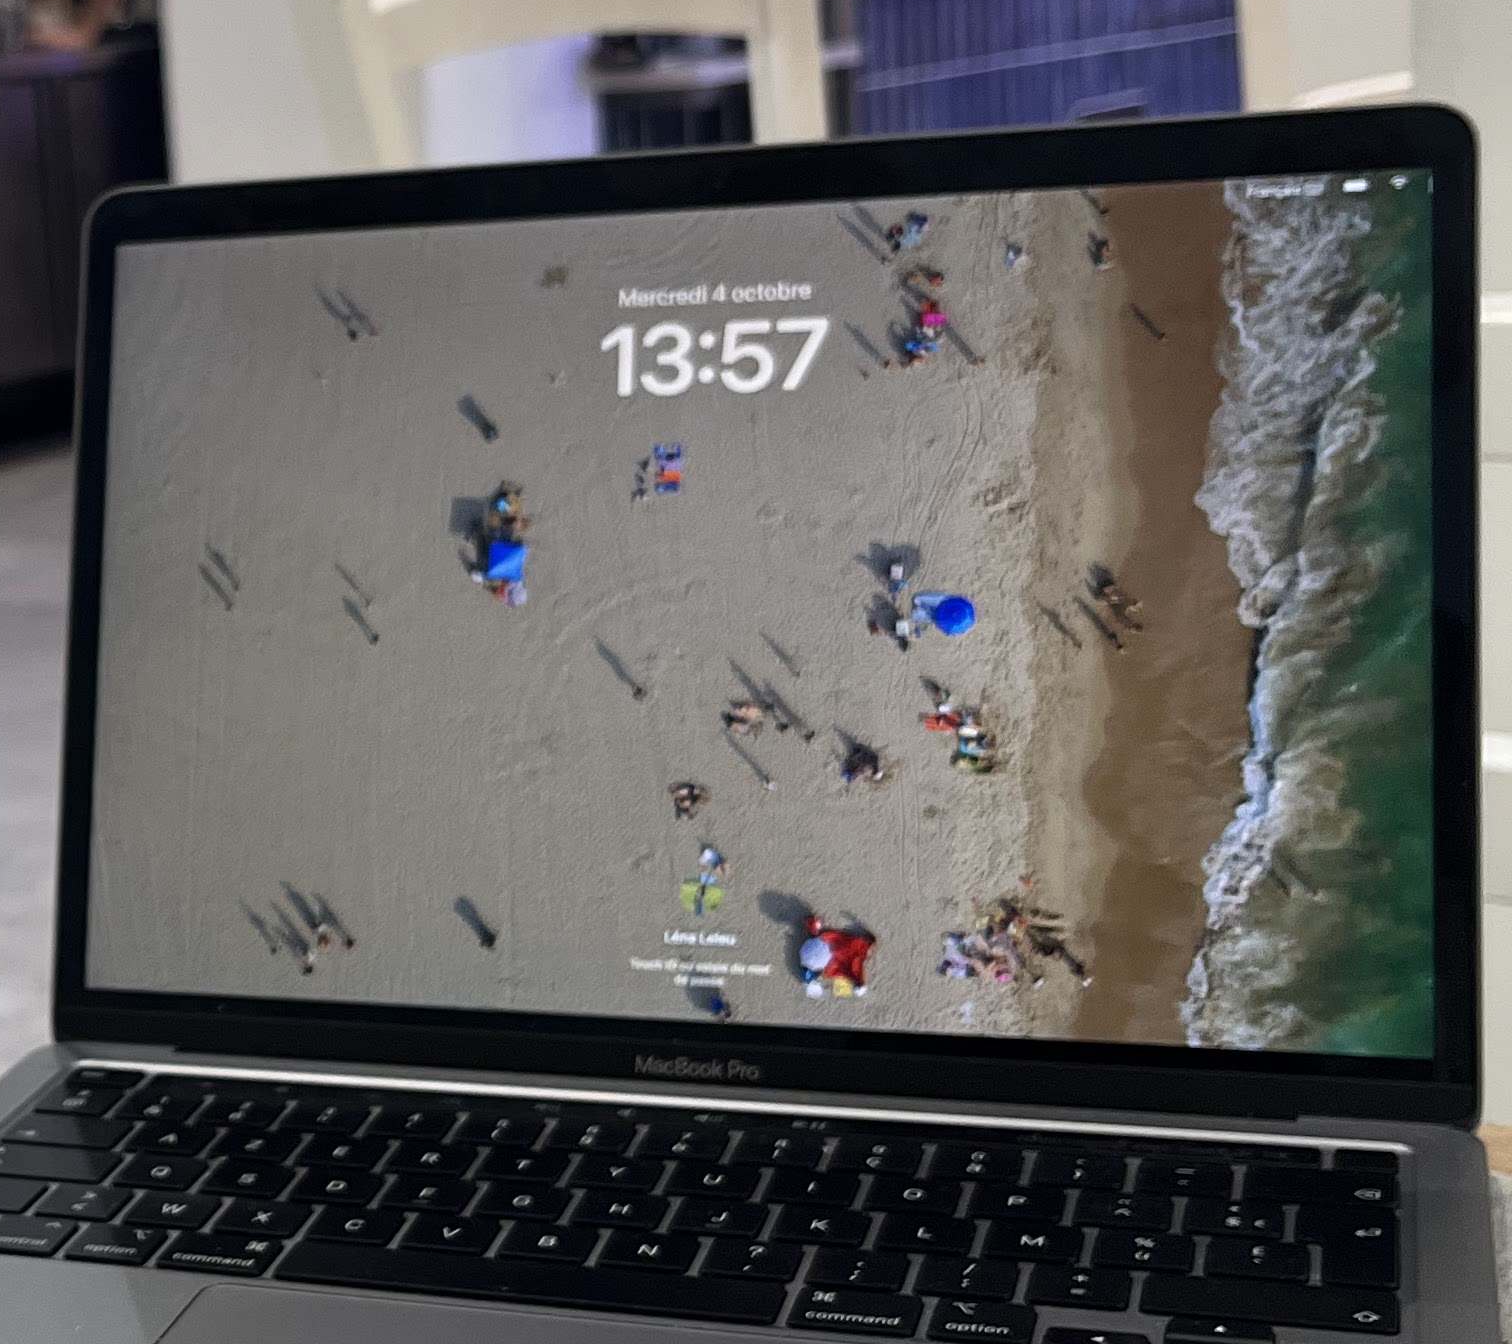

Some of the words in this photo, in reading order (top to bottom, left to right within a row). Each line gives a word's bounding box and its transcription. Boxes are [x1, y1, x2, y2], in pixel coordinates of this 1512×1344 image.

[618, 284, 708, 308] Mercredi
[712, 283, 726, 303] 4
[732, 281, 813, 304] octobre
[600, 317, 830, 397] 13:57
[635, 1056, 724, 1079] MacBook
[727, 1058, 760, 1080] Pro
[172, 1252, 255, 1267] command
[805, 1310, 901, 1326] command
[945, 1322, 1009, 1334] option
